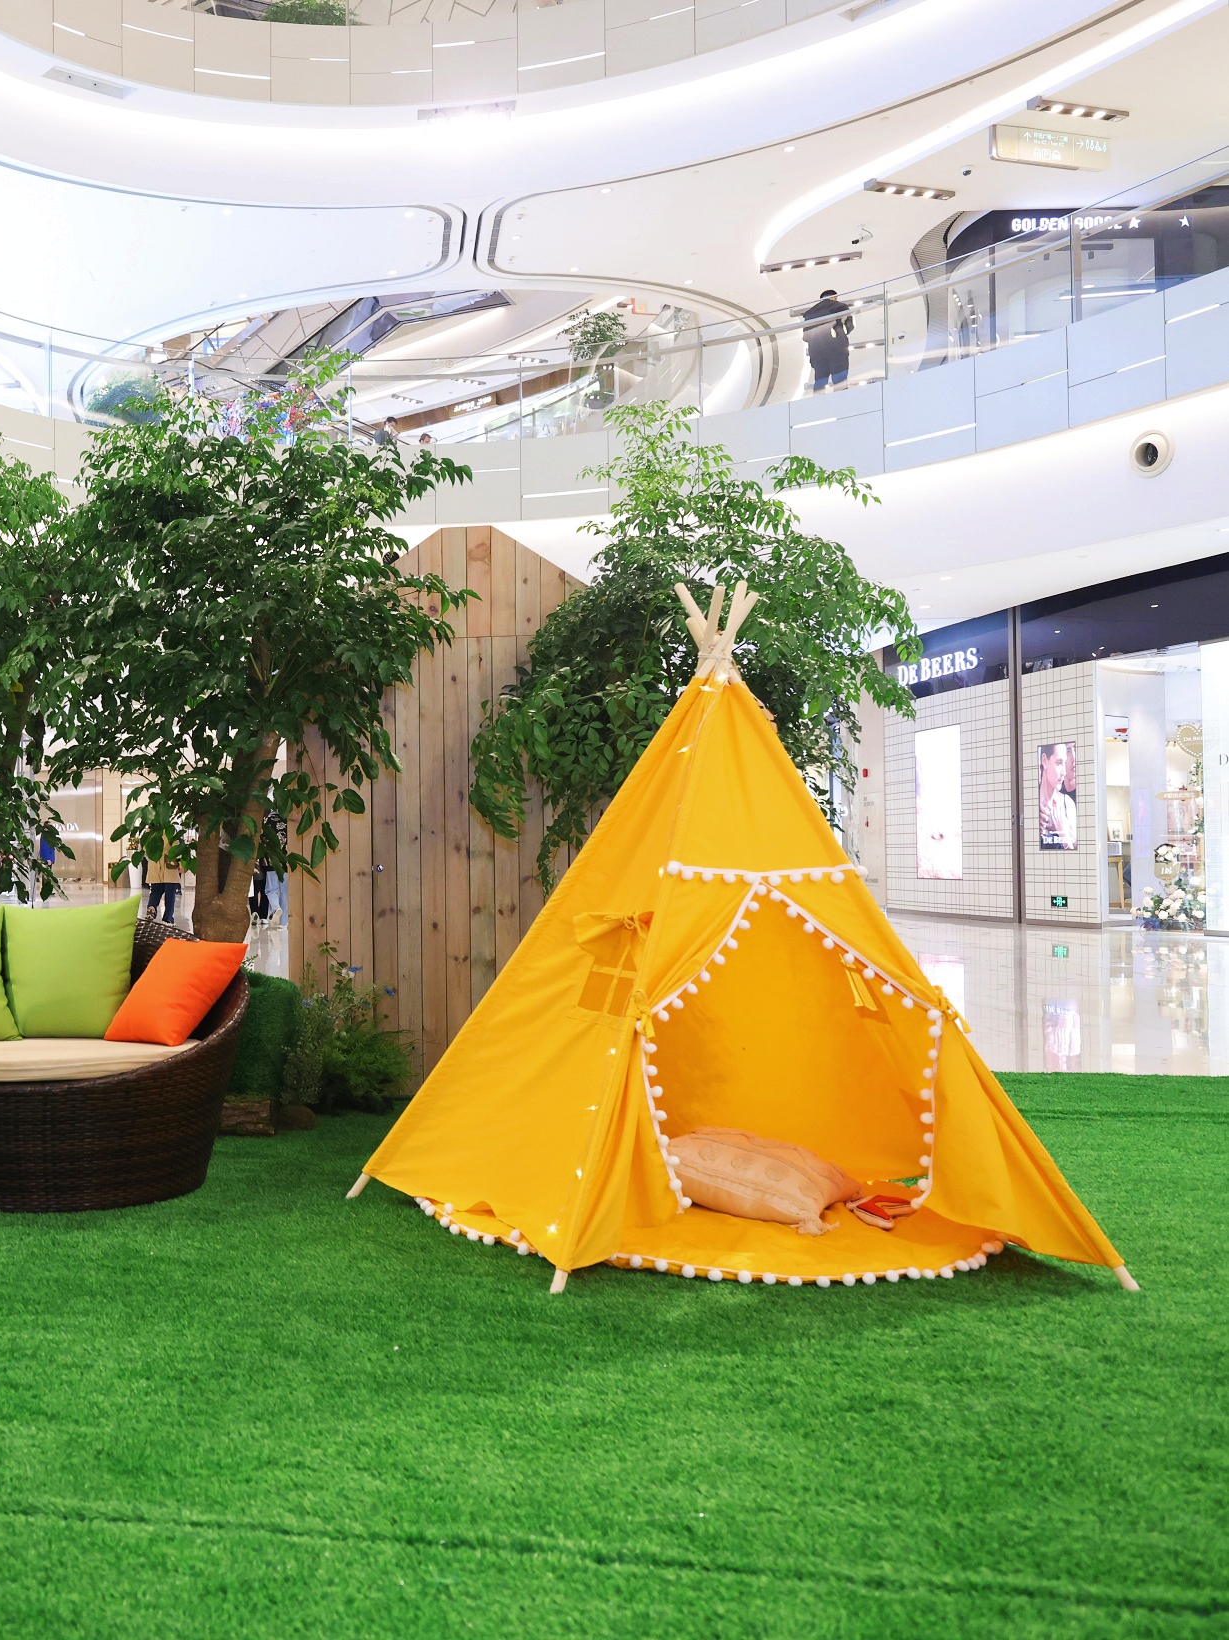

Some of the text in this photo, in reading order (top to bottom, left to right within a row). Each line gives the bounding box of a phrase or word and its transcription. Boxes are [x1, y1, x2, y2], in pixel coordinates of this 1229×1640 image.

[1011, 215, 1122, 232] GOLDEN GOO
[897, 647, 979, 686] DE BEERS
